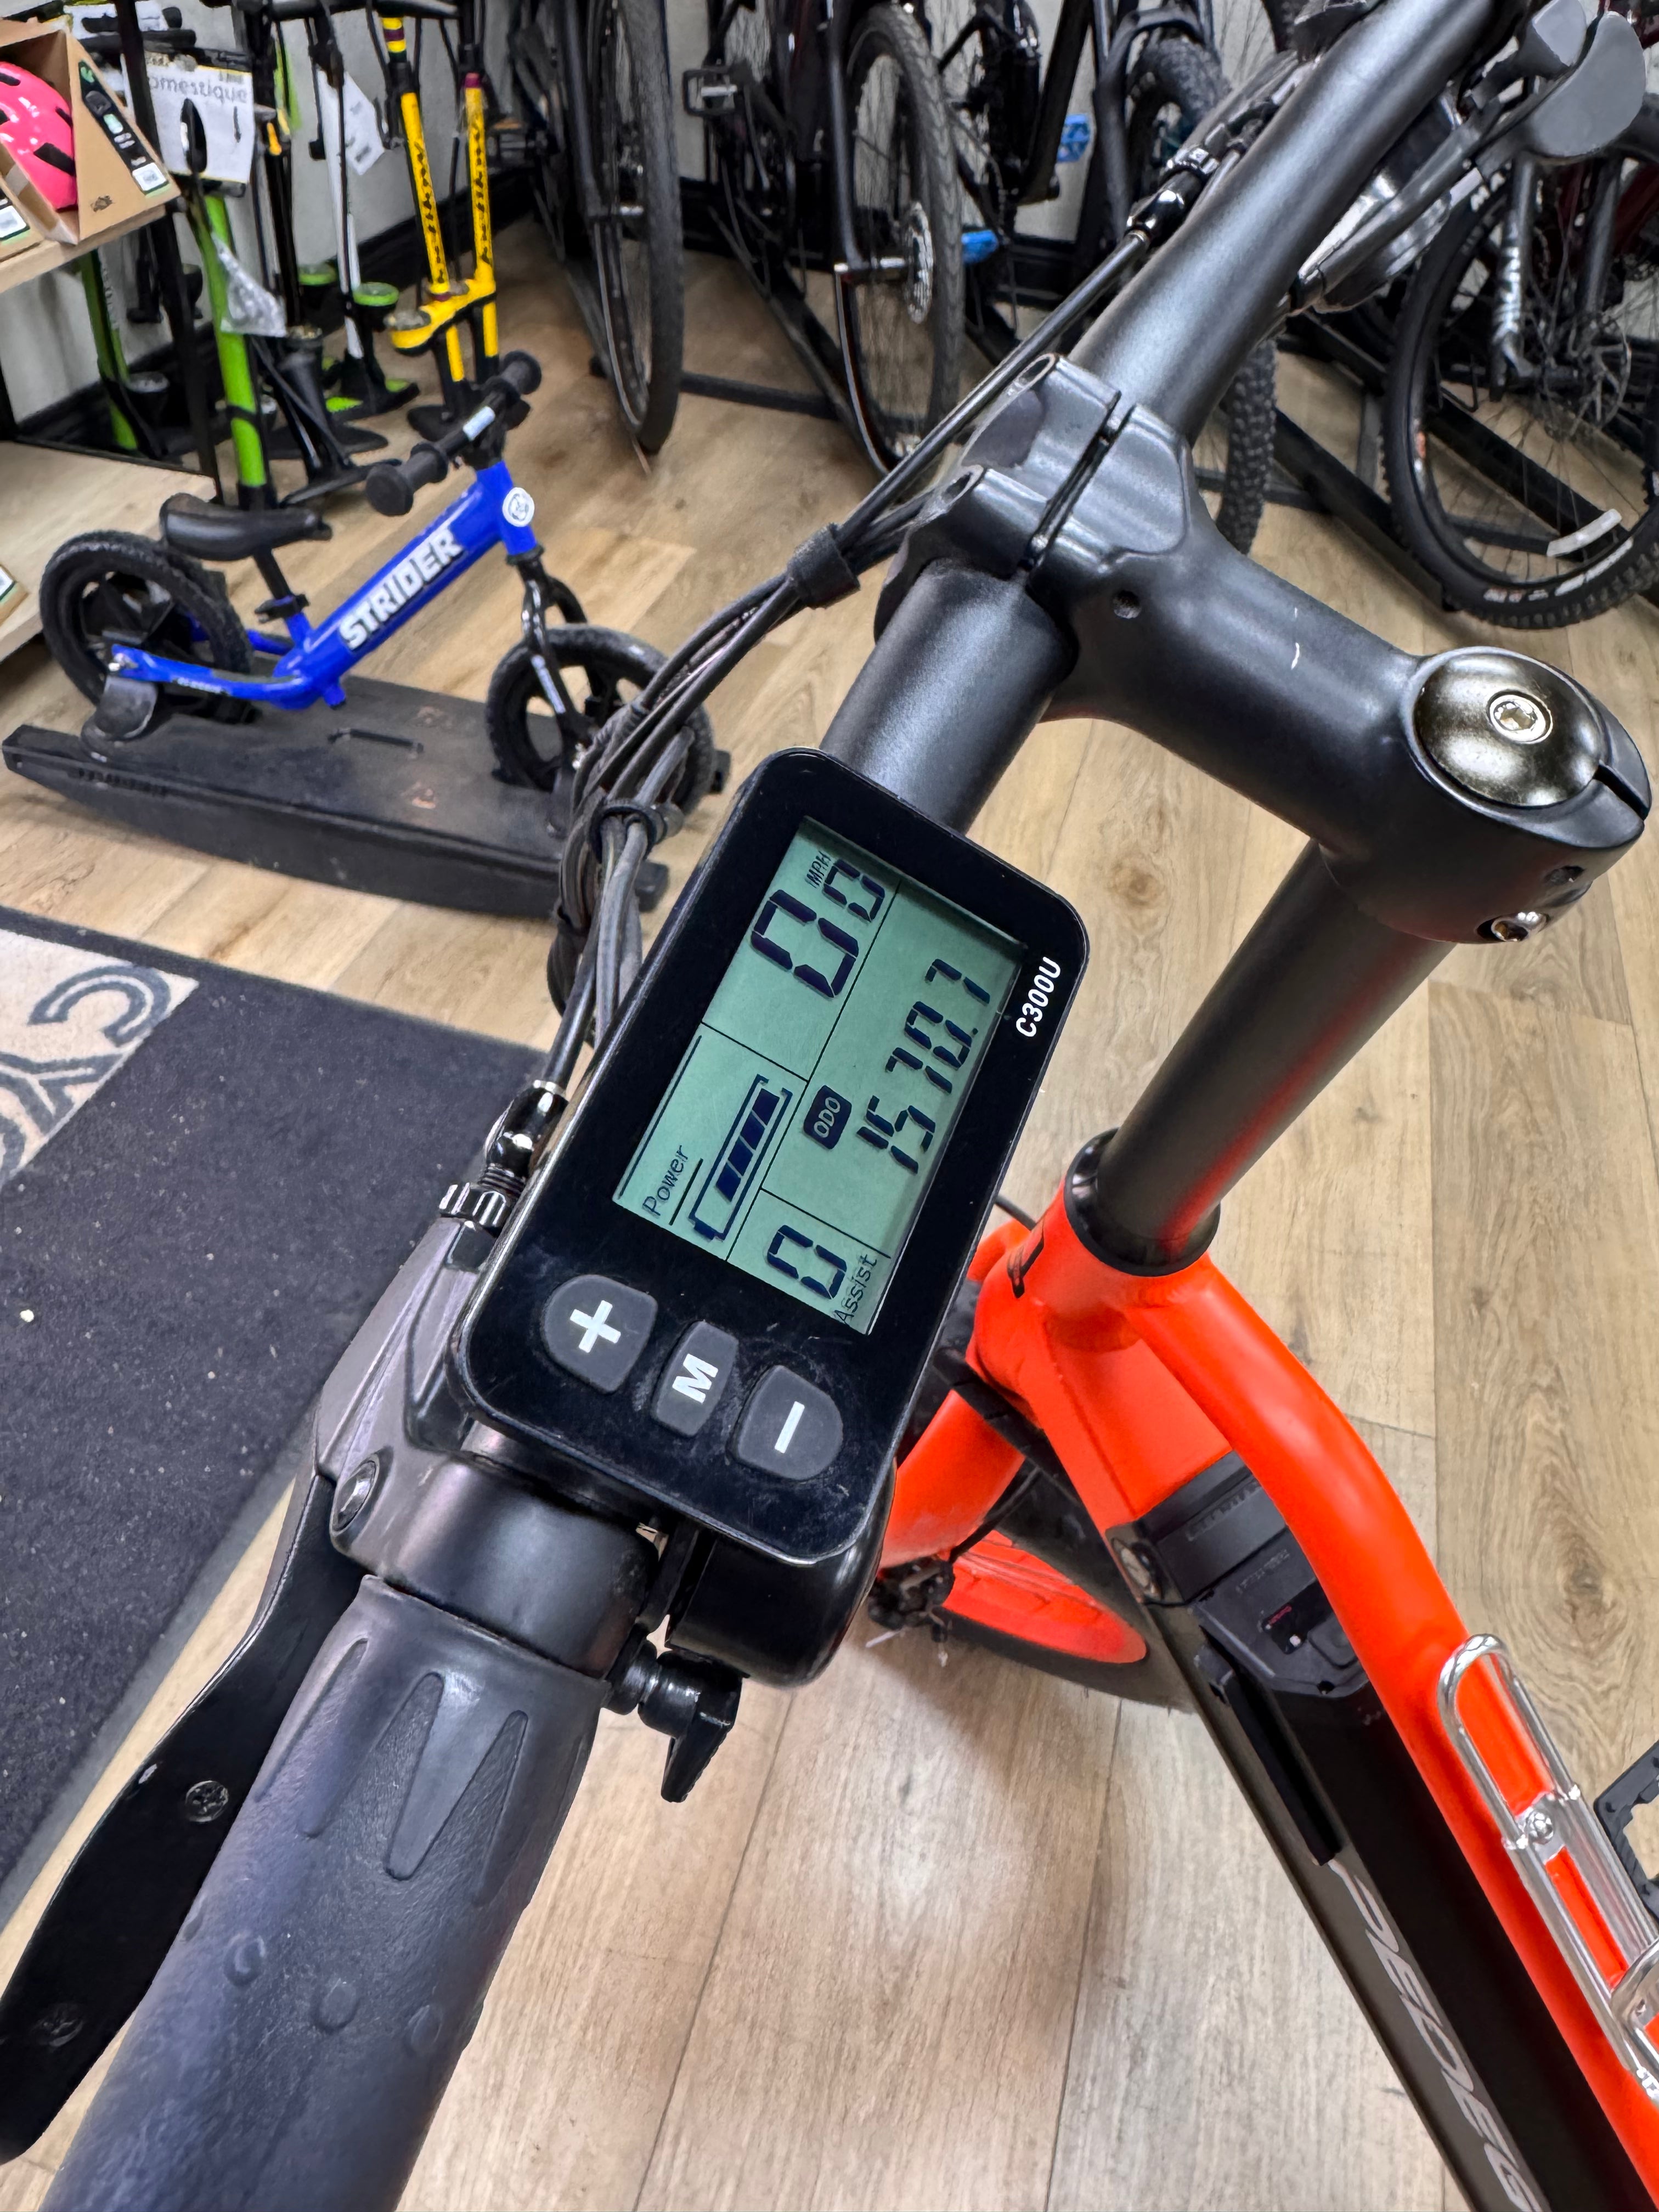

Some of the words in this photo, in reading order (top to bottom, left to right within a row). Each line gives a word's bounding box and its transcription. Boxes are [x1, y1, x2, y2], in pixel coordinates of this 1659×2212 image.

[339, 528, 464, 651] STRIDER
[805, 850, 832, 889] MPH
[1015, 956, 1061, 1038] C300U
[857, 958, 991, 1174] 1570.7
[814, 1096, 842, 1138] ODO
[642, 1145, 688, 1216] Power
[767, 1225, 847, 1300] 0
[833, 1254, 878, 1323] Assist
[672, 1353, 719, 1404] M
